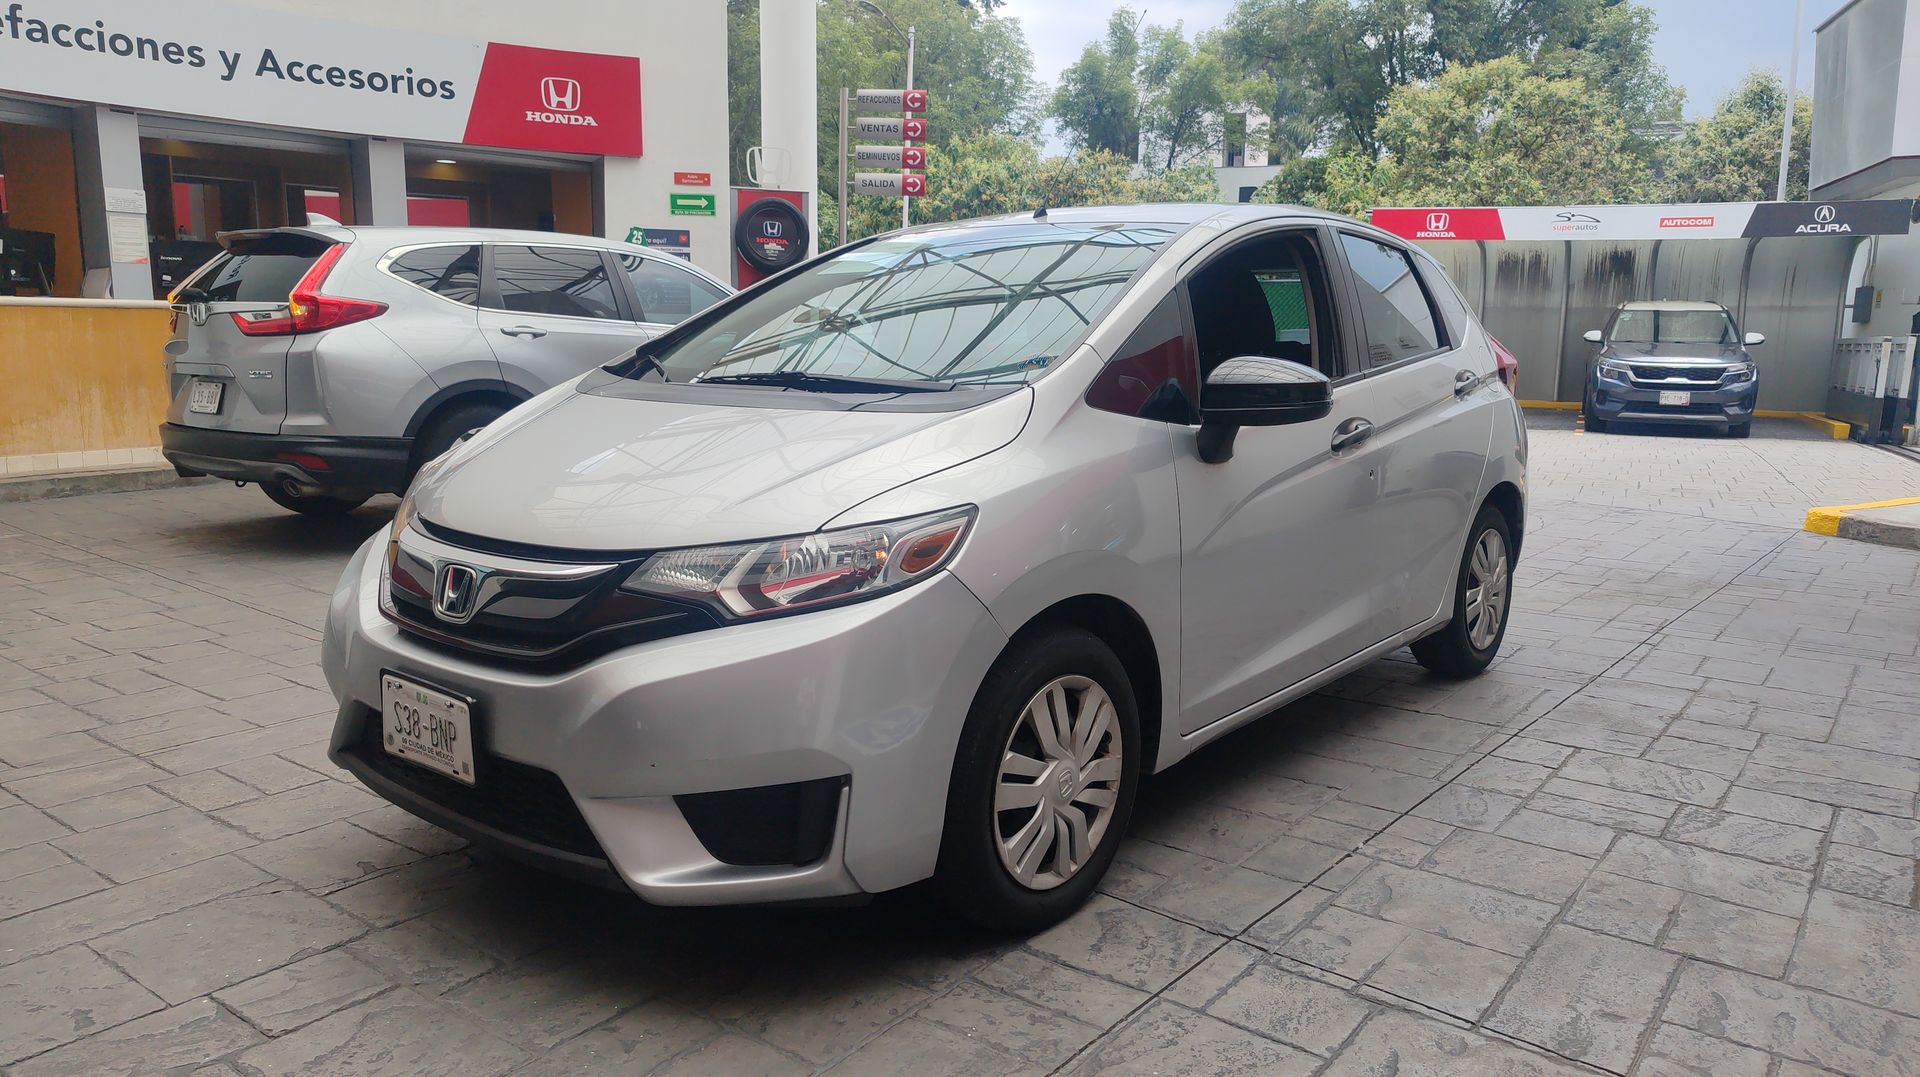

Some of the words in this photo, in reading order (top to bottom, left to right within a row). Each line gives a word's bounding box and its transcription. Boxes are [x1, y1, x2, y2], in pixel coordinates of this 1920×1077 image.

[0, 3, 206, 67] facciones
[218, 49, 241, 82] y
[255, 48, 456, 100] Accesorios
[857, 95, 901, 104] REFACCIONES
[525, 111, 598, 126] HONDA
[860, 124, 899, 133] VENTAS
[857, 151, 901, 161] SEMINUEVOS
[861, 179, 895, 188] SALIDA
[1661, 218, 1712, 226] AUTOCOM
[1552, 224, 1598, 232] superautos
[1795, 223, 1851, 233] ACURA
[631, 230, 643, 245] 25
[755, 237, 789, 245] HONDA
[393, 700, 457, 754] S38-BNP
[408, 739, 427, 752] CIUDAD
[427, 746, 434, 755] DE
